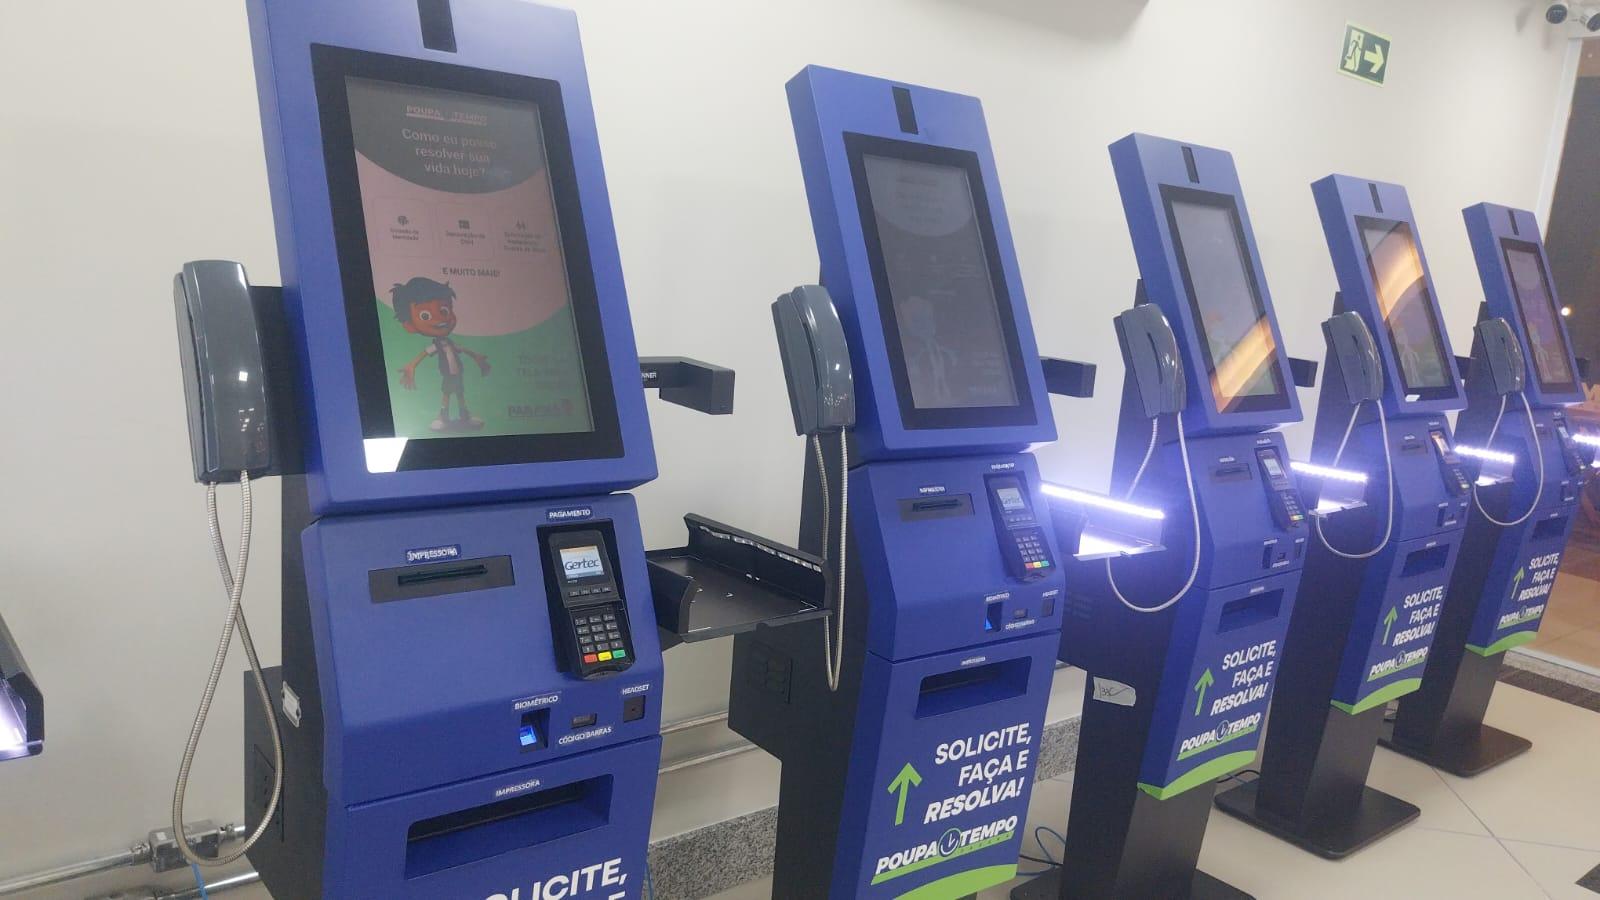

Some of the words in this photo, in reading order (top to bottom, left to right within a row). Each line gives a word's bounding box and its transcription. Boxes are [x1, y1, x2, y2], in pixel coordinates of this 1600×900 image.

[401, 128, 440, 143] Como
[415, 147, 465, 161] resolver
[549, 508, 591, 519] PAGAMENTO
[407, 547, 458, 561] IMPRESSORA
[565, 558, 600, 570] Gertec
[1528, 552, 1560, 570] SOLICITE,
[1403, 585, 1444, 608] SOLICITE,
[1409, 608, 1432, 625] FAÇA
[1432, 603, 1441, 617] E
[1499, 610, 1520, 625] POUPA
[1524, 604, 1545, 618] TEMPO
[1393, 621, 1436, 647] RESOLVA!
[1222, 640, 1277, 670] SOLICITE,
[1369, 657, 1396, 676] POUPA
[1403, 646, 1429, 664] TEMPO
[1232, 667, 1264, 688] FAÇA
[1265, 661, 1274, 677] E
[622, 684, 649, 695] HEADSET
[1210, 682, 1269, 716] RESOLVA!
[514, 695, 558, 710] BIOMÉTRICO
[559, 733, 585, 744] CÓDIGO
[586, 727, 612, 738] BARRAS
[935, 722, 1032, 765] SOLICITE,
[1180, 729, 1216, 753] POUPA
[1227, 712, 1261, 735] TEMPO
[959, 754, 1012, 786] FAÇA
[1016, 750, 1029, 770] E
[496, 779, 540, 797] IMPRESSORA
[924, 777, 1025, 824] RESOLVA!
[875, 840, 938, 875] POUPA
[960, 815, 1018, 844] TEMPO
